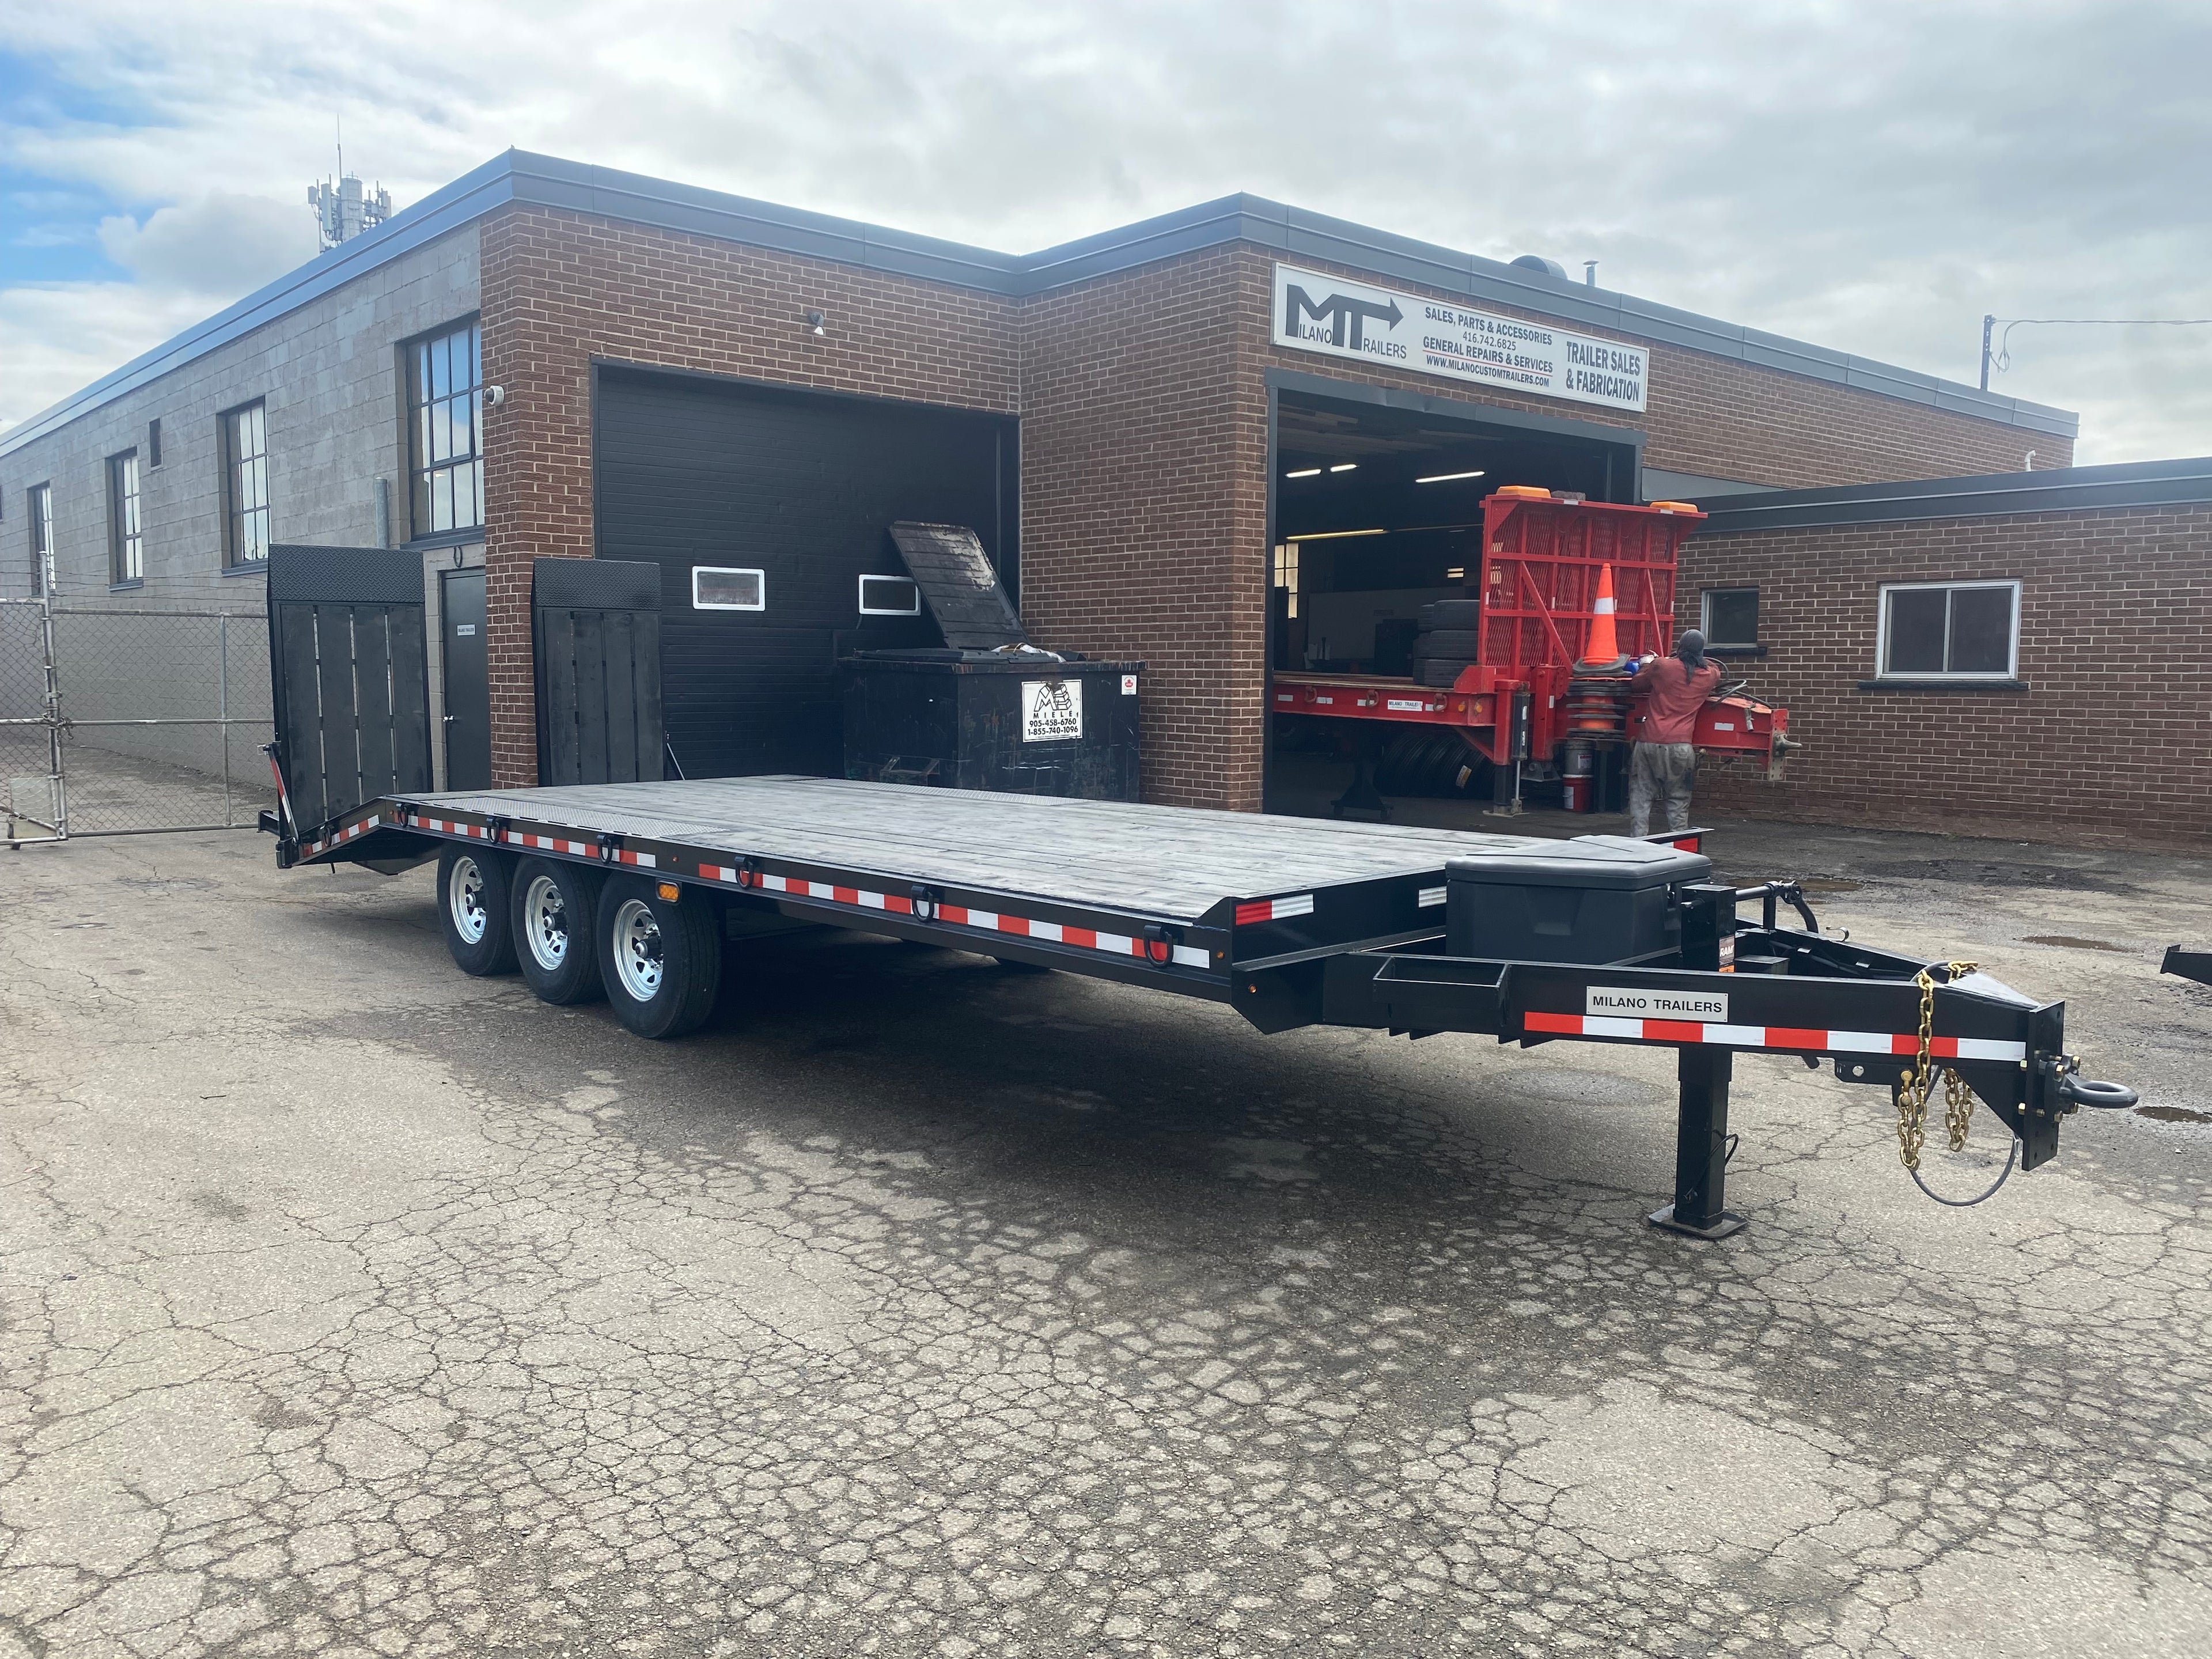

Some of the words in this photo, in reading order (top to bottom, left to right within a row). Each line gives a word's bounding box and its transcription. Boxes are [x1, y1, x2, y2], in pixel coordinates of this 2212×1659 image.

[1425, 306, 1456, 327] SALES,
[1458, 314, 1485, 331] PARTS
[1487, 321, 1494, 333] &
[1496, 323, 1552, 346] ACCESSORIES
[1463, 331, 1516, 351] 416.742.6825
[1423, 336, 1464, 355] GENERAL
[1466, 345, 1503, 363] REPAIRS
[1506, 353, 1513, 365] &
[1514, 355, 1553, 373] SERVICES
[1566, 341, 1608, 369] TRAILER
[1611, 351, 1641, 376] SALES
[1426, 354, 1550, 387] WWW.MILANOCUSTOMTRAILERS.COM
[1566, 368, 1574, 389] &
[1577, 370, 1639, 402] FABRICATION
[1029, 718, 1077, 727] 905-458-6760
[1033, 710, 1073, 719] MIELE
[1028, 726, 1078, 736] 1-855-740-1096
[1593, 995, 1647, 1008] MILANO
[1653, 999, 1722, 1013] TRAILERS
